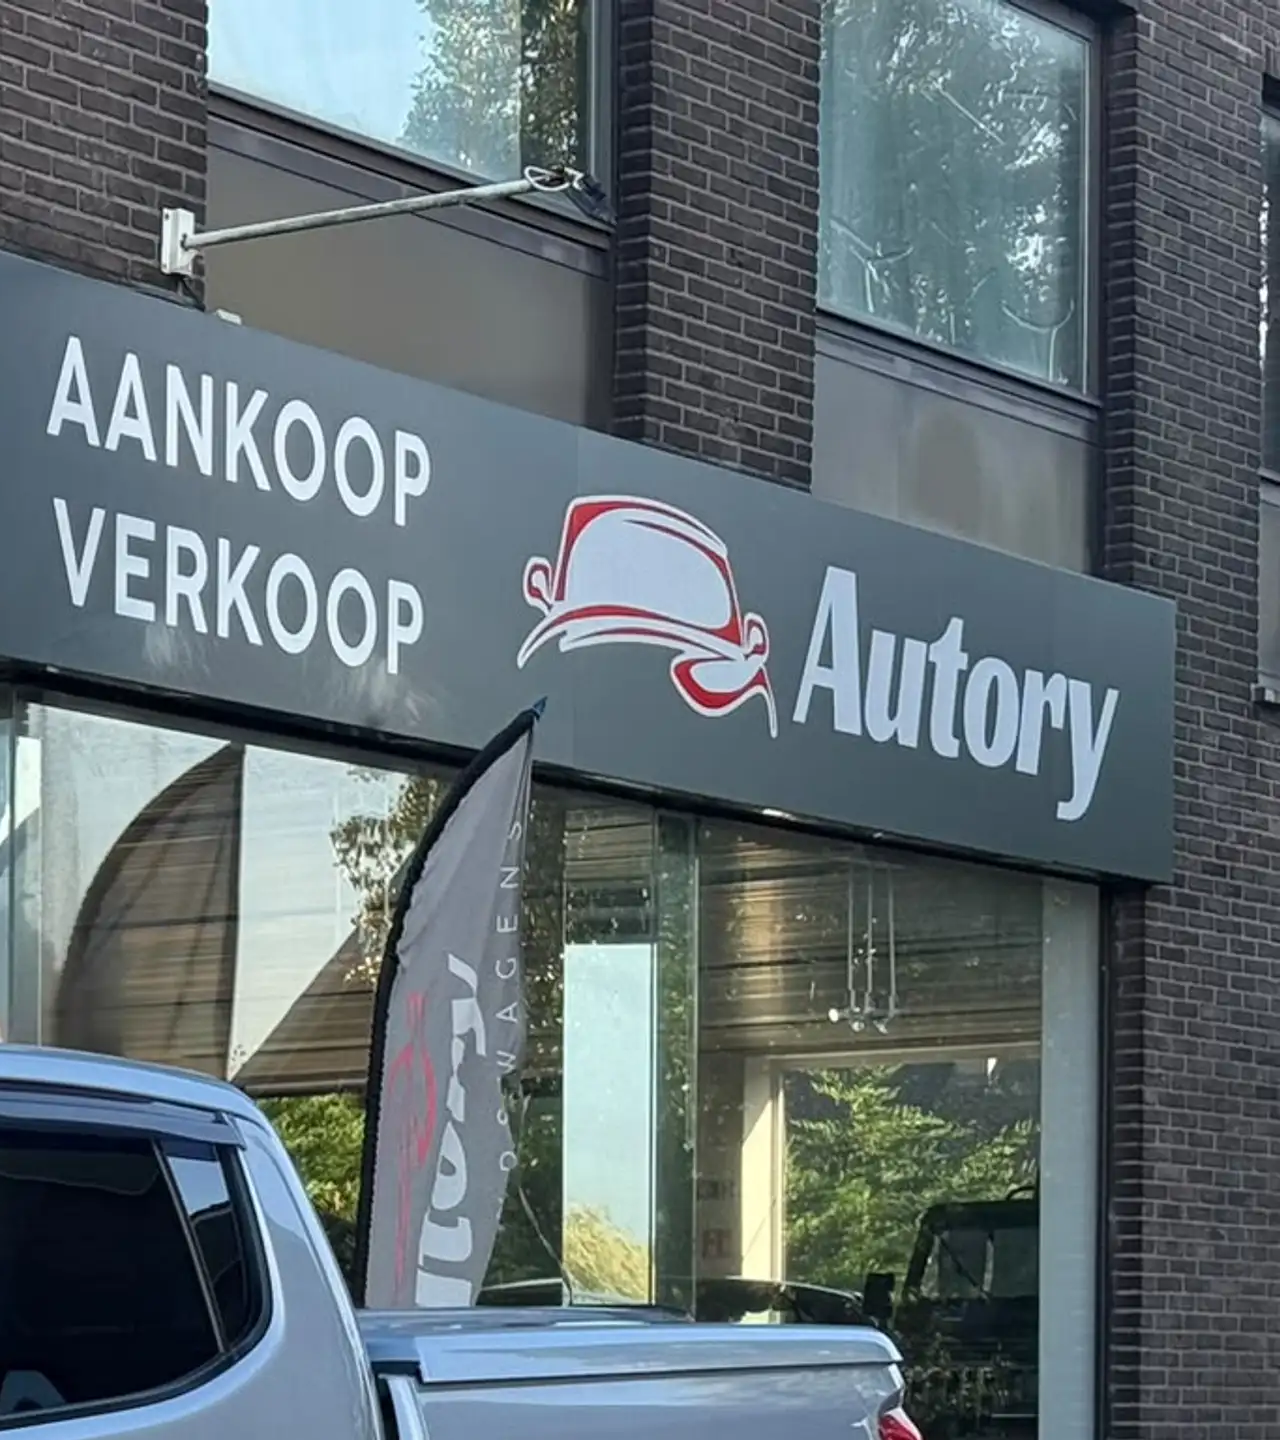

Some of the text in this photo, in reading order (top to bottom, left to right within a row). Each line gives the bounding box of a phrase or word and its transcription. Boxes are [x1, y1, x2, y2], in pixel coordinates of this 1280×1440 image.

[46, 335, 431, 527] AANKOOP
[53, 497, 424, 676] VERKOOP
[792, 565, 1119, 822] Autory
